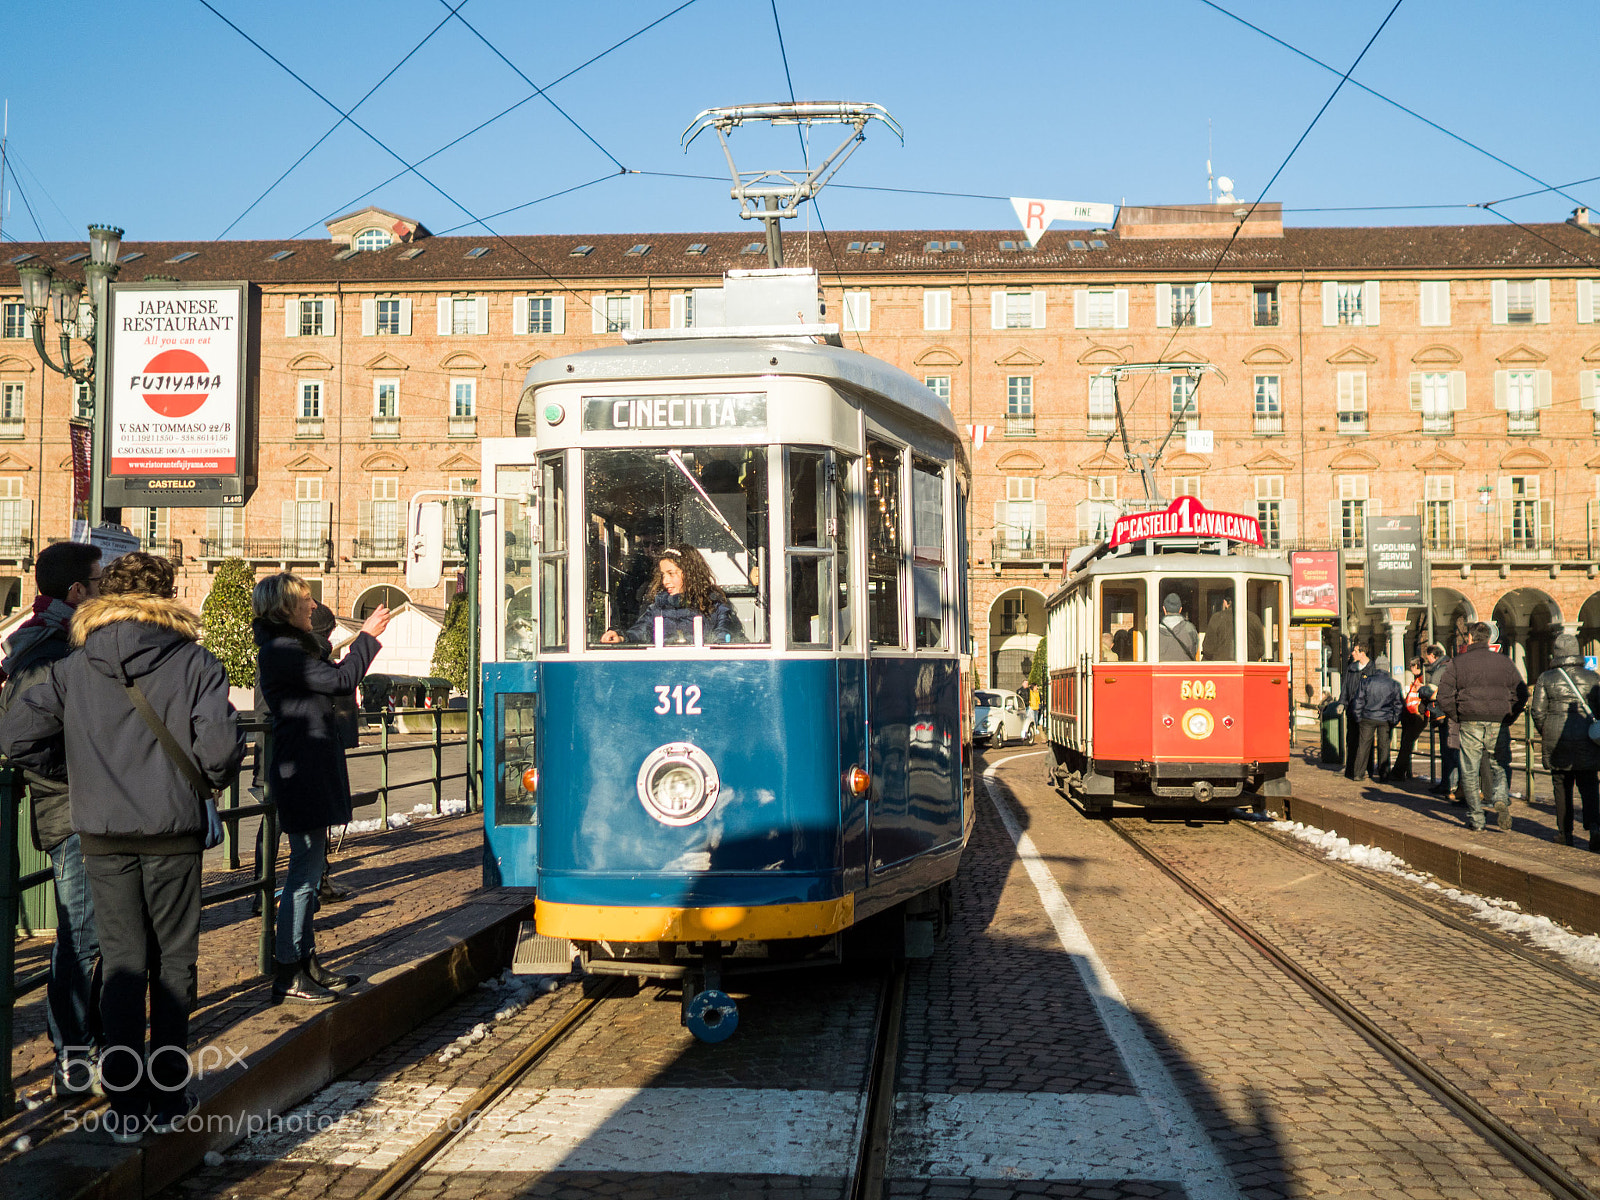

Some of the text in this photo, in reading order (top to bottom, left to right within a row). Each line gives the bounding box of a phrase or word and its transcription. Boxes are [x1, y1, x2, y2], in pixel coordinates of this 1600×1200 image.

[1026, 201, 1045, 230] R
[1074, 207, 1092, 217] FINE
[138, 300, 218, 315] JAPANESE
[122, 316, 234, 332] RESTAURANT
[144, 335, 211, 348] All you can eat
[130, 374, 222, 391] FUJIYAMA
[129, 423, 150, 433] SAN
[152, 423, 207, 433] TOMMASO
[208, 422, 231, 433] 22/B
[129, 461, 218, 470] www.ristorantefujiyama.com
[148, 480, 196, 488] CASTELLO
[1130, 512, 1178, 539] CASTELLO
[1178, 498, 1194, 532] 1
[1193, 512, 1258, 541] CAVALCAVIA
[1373, 543, 1416, 551] CAPOLINEA
[1380, 552, 1410, 560] SERVIZI
[1377, 561, 1413, 569] SPECIALI
[1180, 680, 1217, 700] 502
[654, 685, 702, 715] 312
